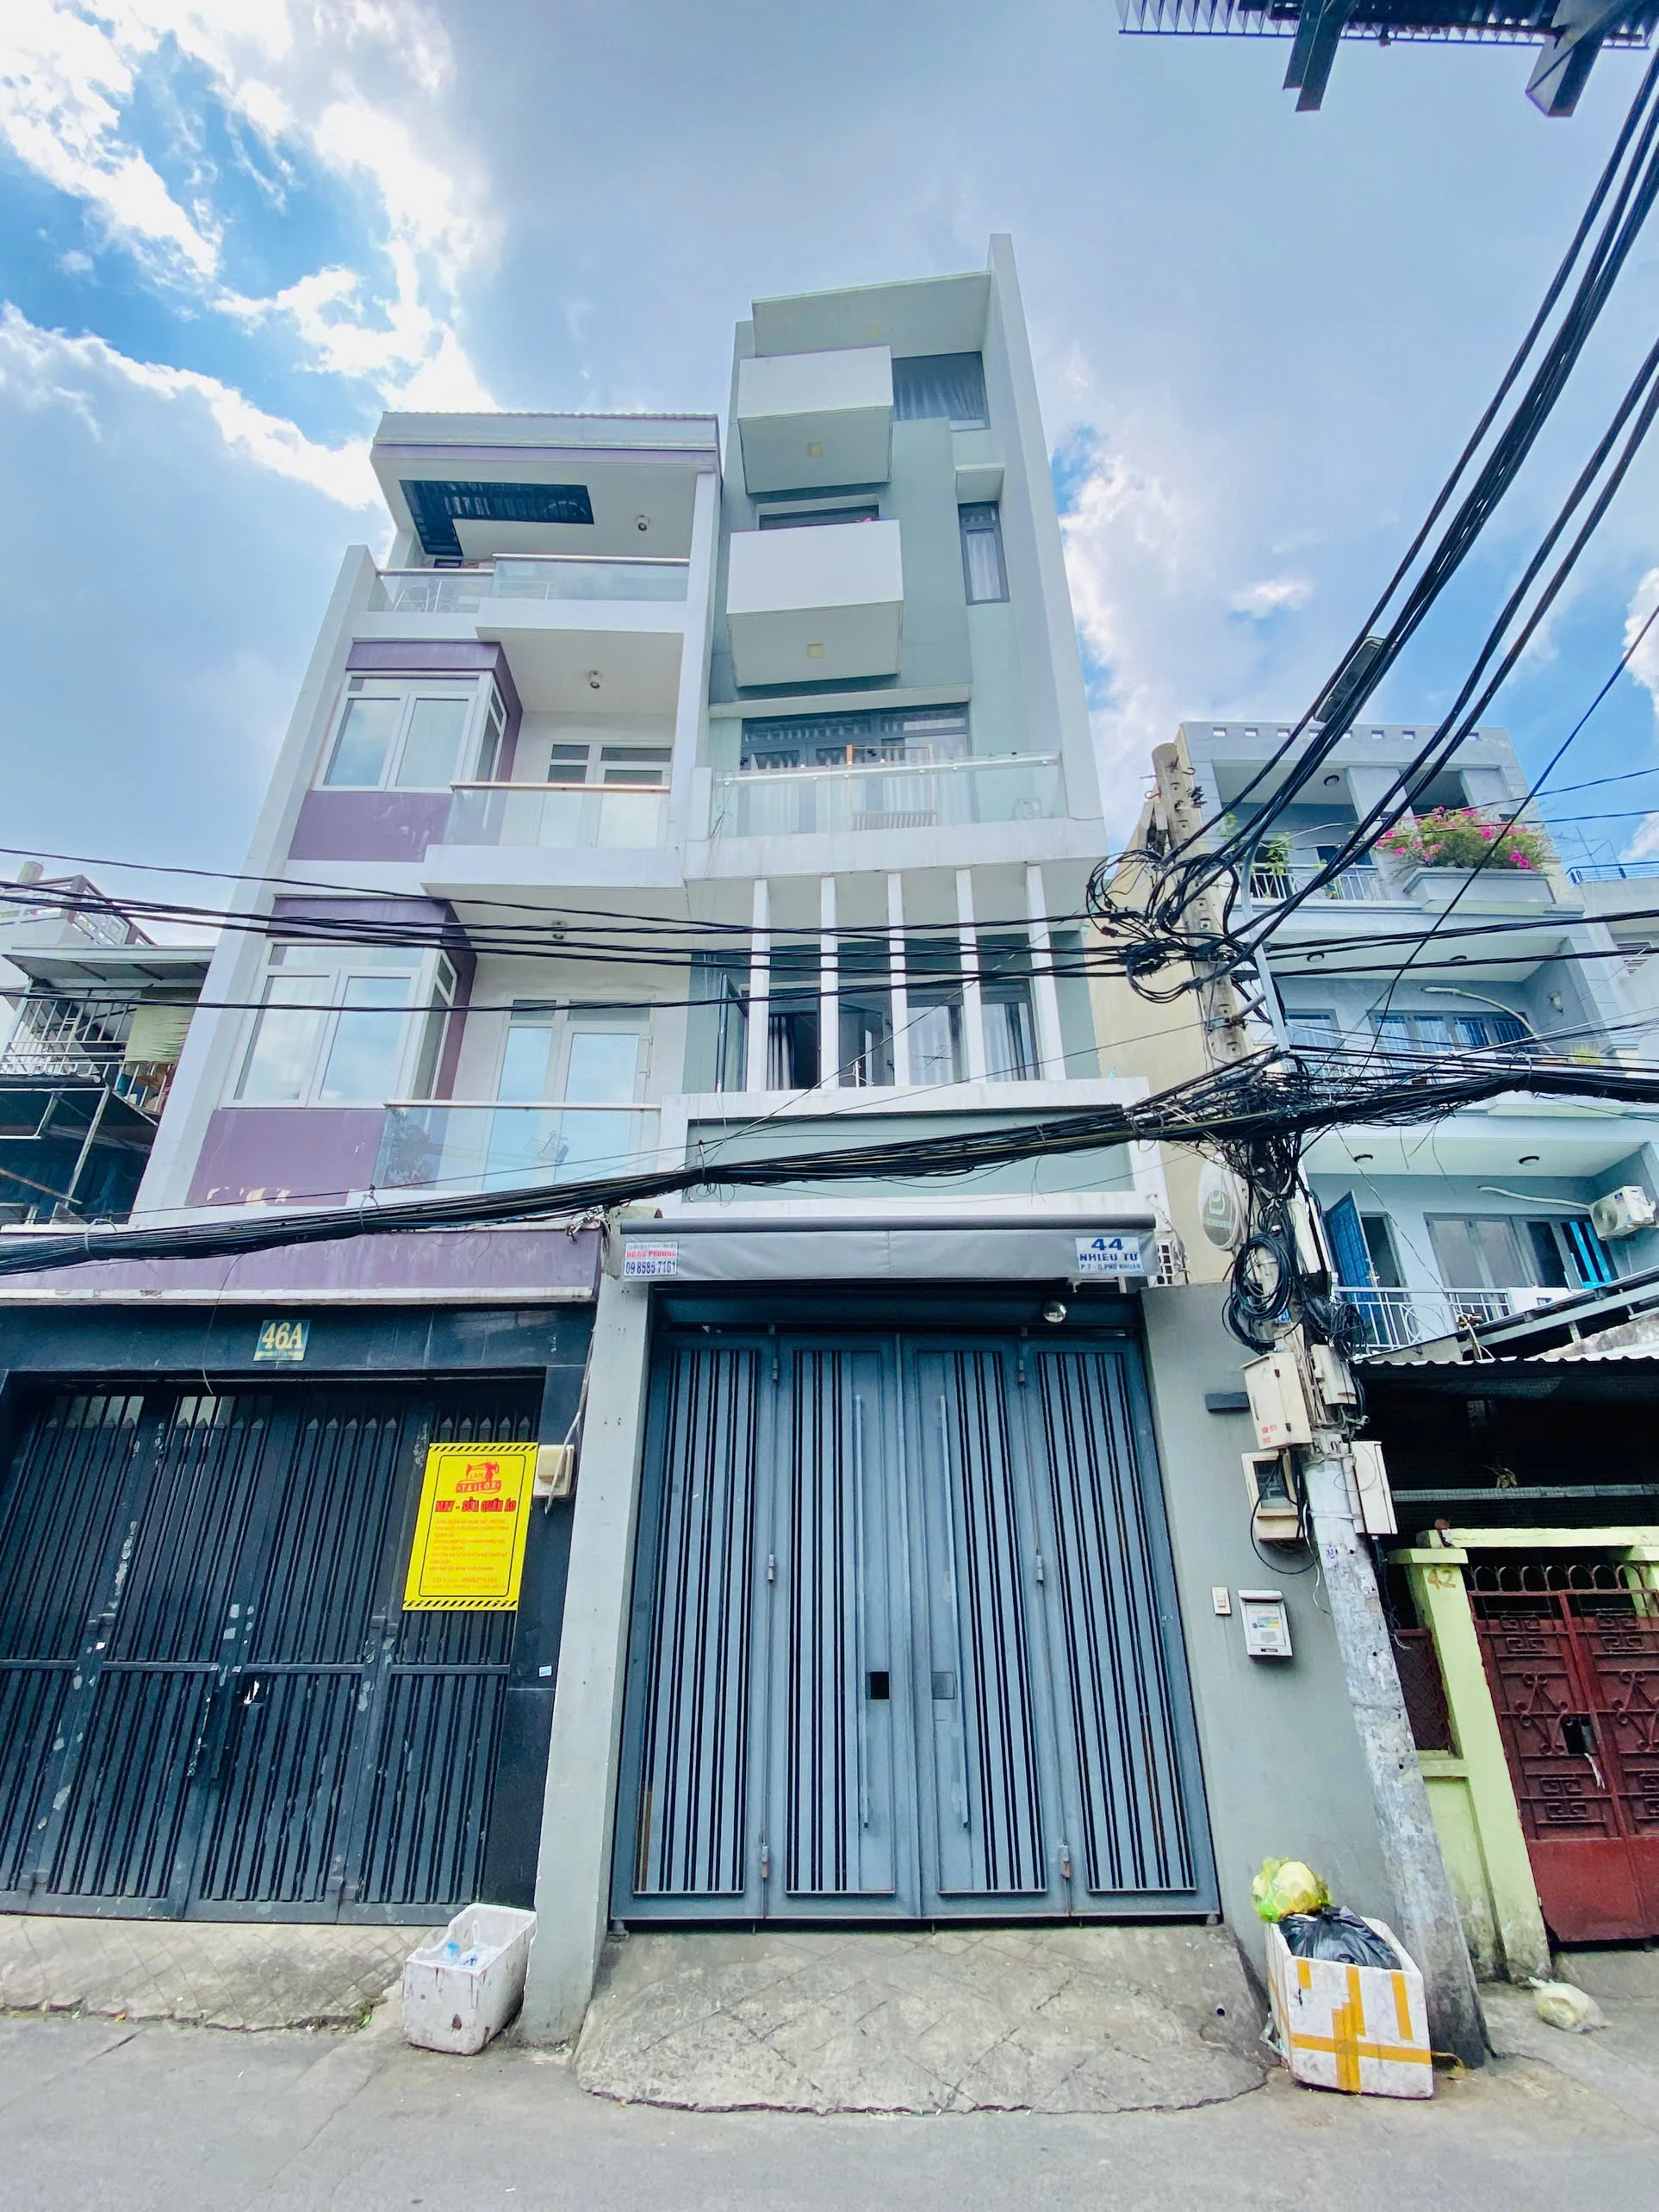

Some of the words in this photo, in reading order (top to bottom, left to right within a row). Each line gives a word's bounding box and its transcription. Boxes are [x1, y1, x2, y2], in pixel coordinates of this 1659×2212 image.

[1091, 1238, 1123, 1251] 44
[625, 1261, 636, 1274] 09
[637, 1261, 656, 1274] 8585
[657, 1260, 676, 1273] 7161
[261, 1322, 303, 1350] 46A
[462, 1481, 497, 1491] TAILOR
[1427, 1569, 1456, 1591] 42
